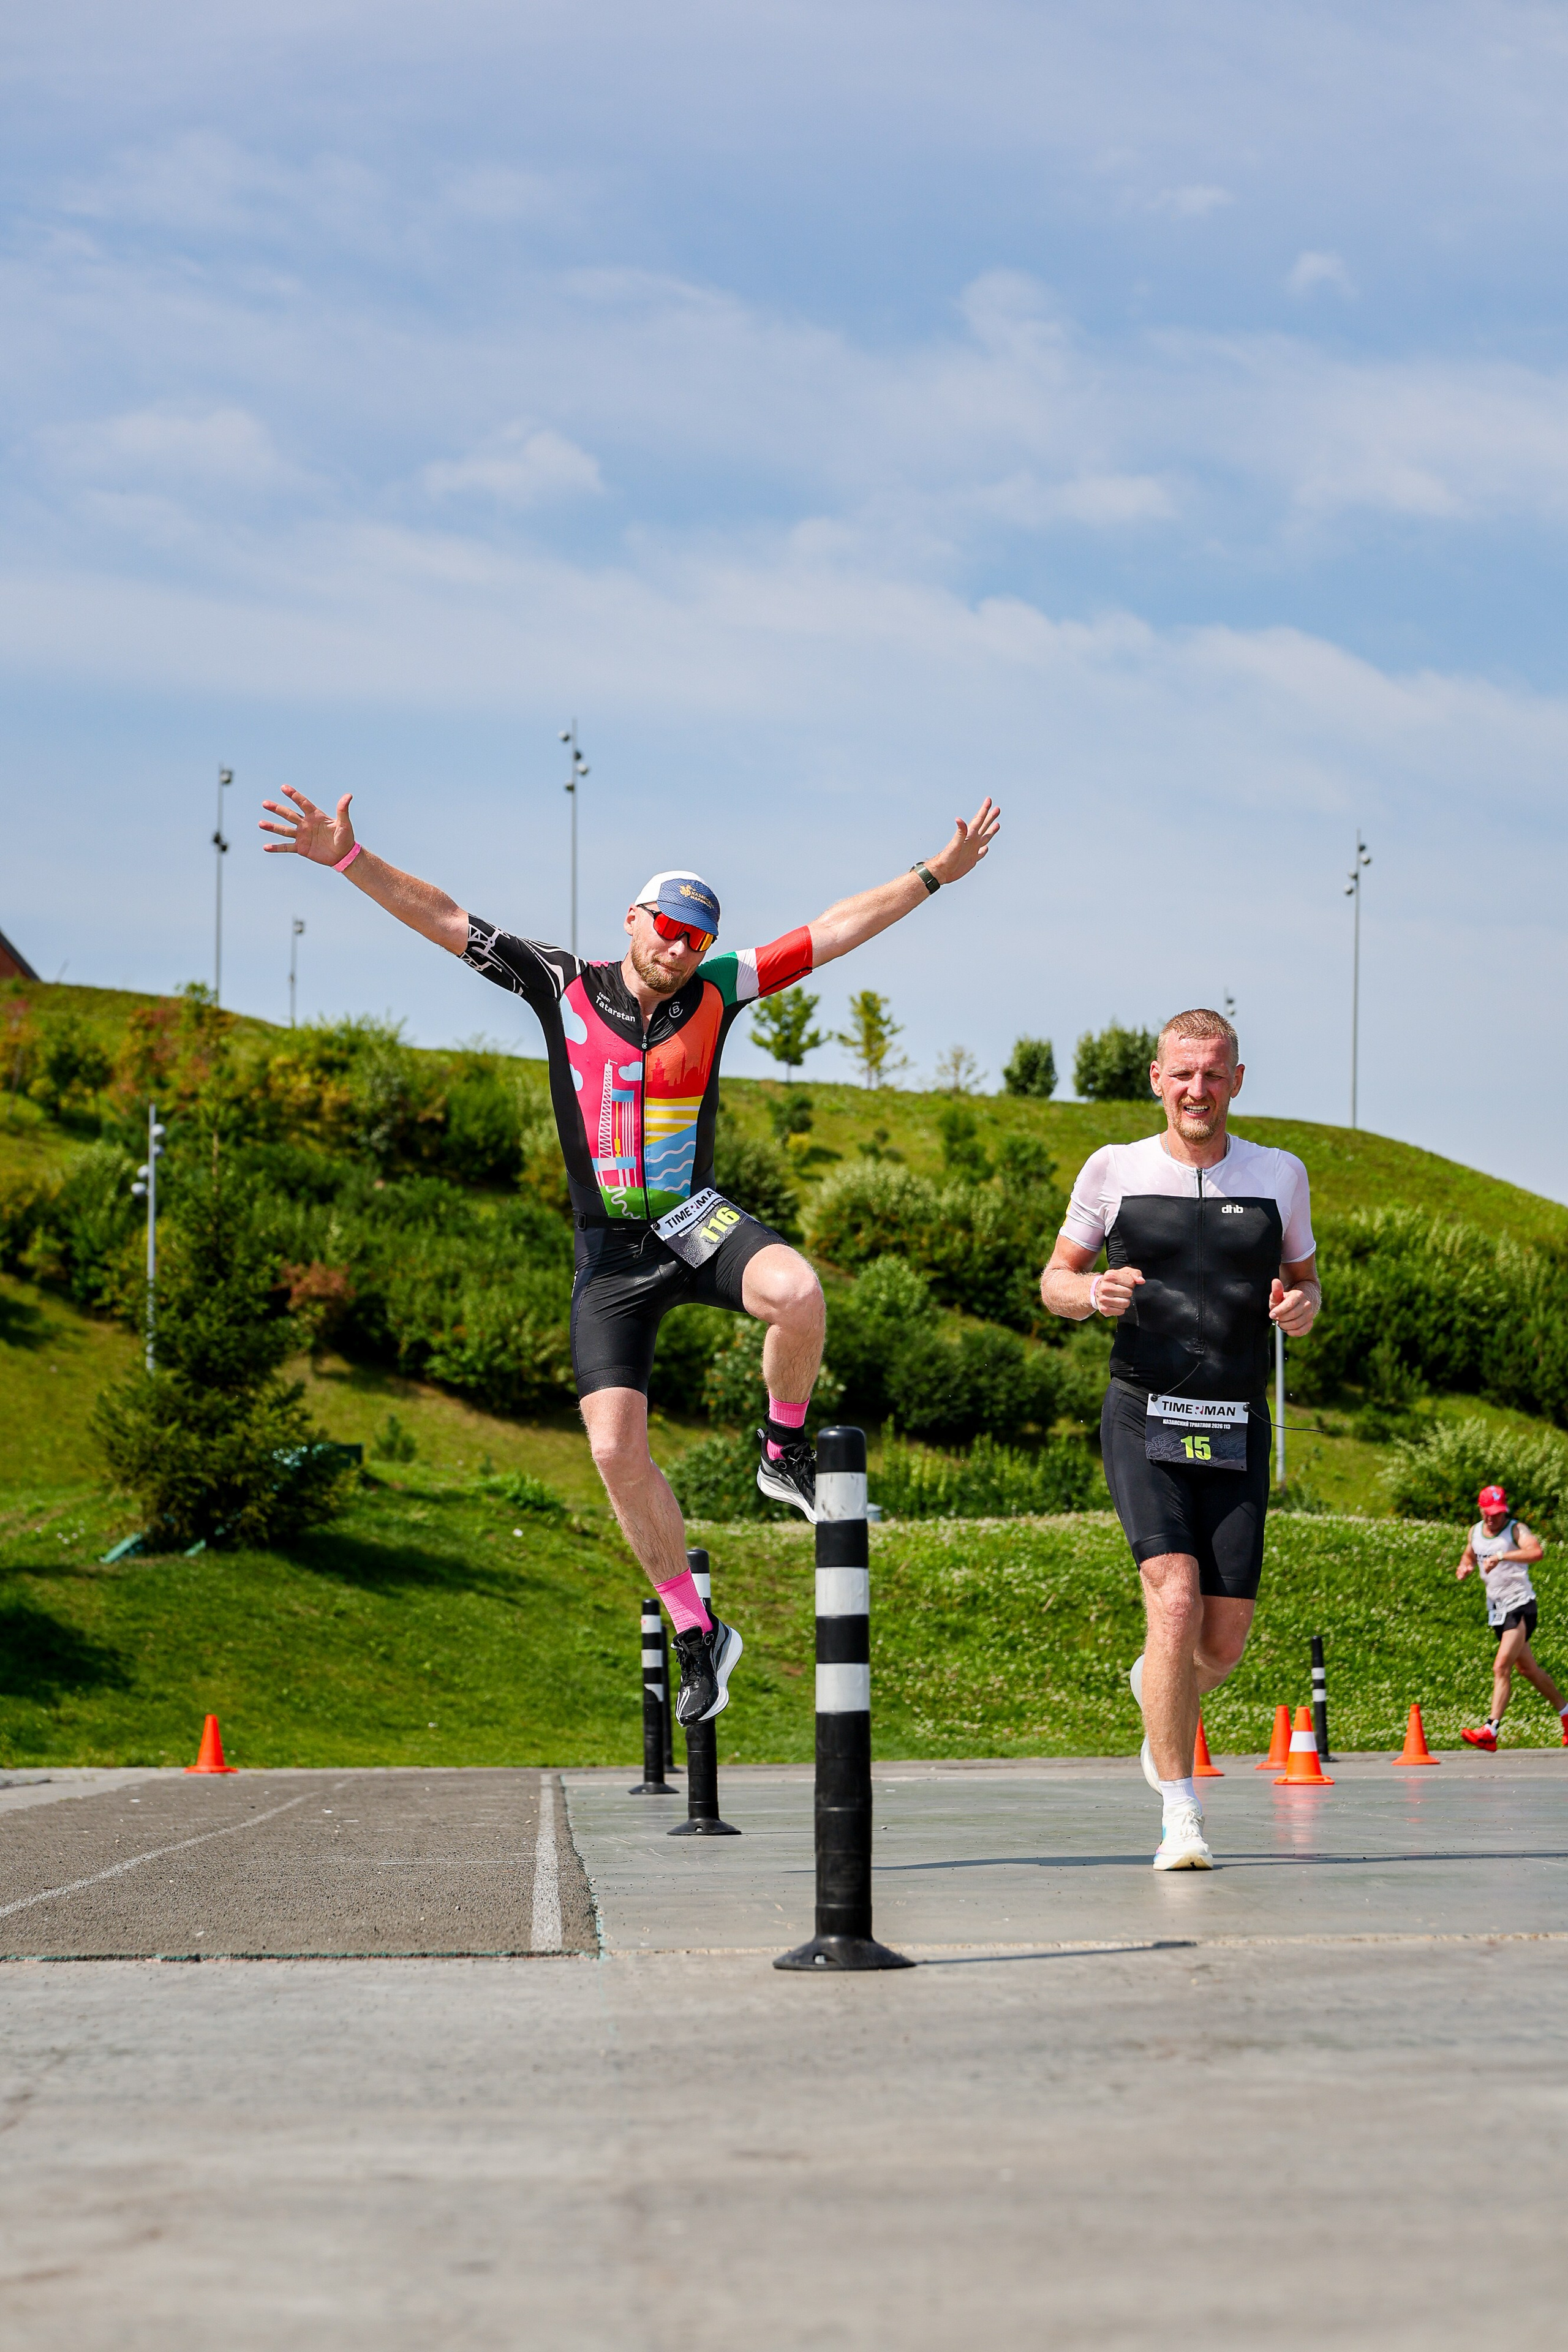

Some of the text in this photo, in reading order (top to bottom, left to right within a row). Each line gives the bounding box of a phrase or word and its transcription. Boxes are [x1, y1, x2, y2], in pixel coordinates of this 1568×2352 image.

[599, 992, 611, 1003] team
[595, 995, 635, 1022] Tatarstan
[1221, 1205, 1243, 1213] dhb
[699, 1206, 740, 1243] 116
[1162, 1401, 1235, 1416] TIMERMAN
[1181, 1436, 1212, 1460] 15
